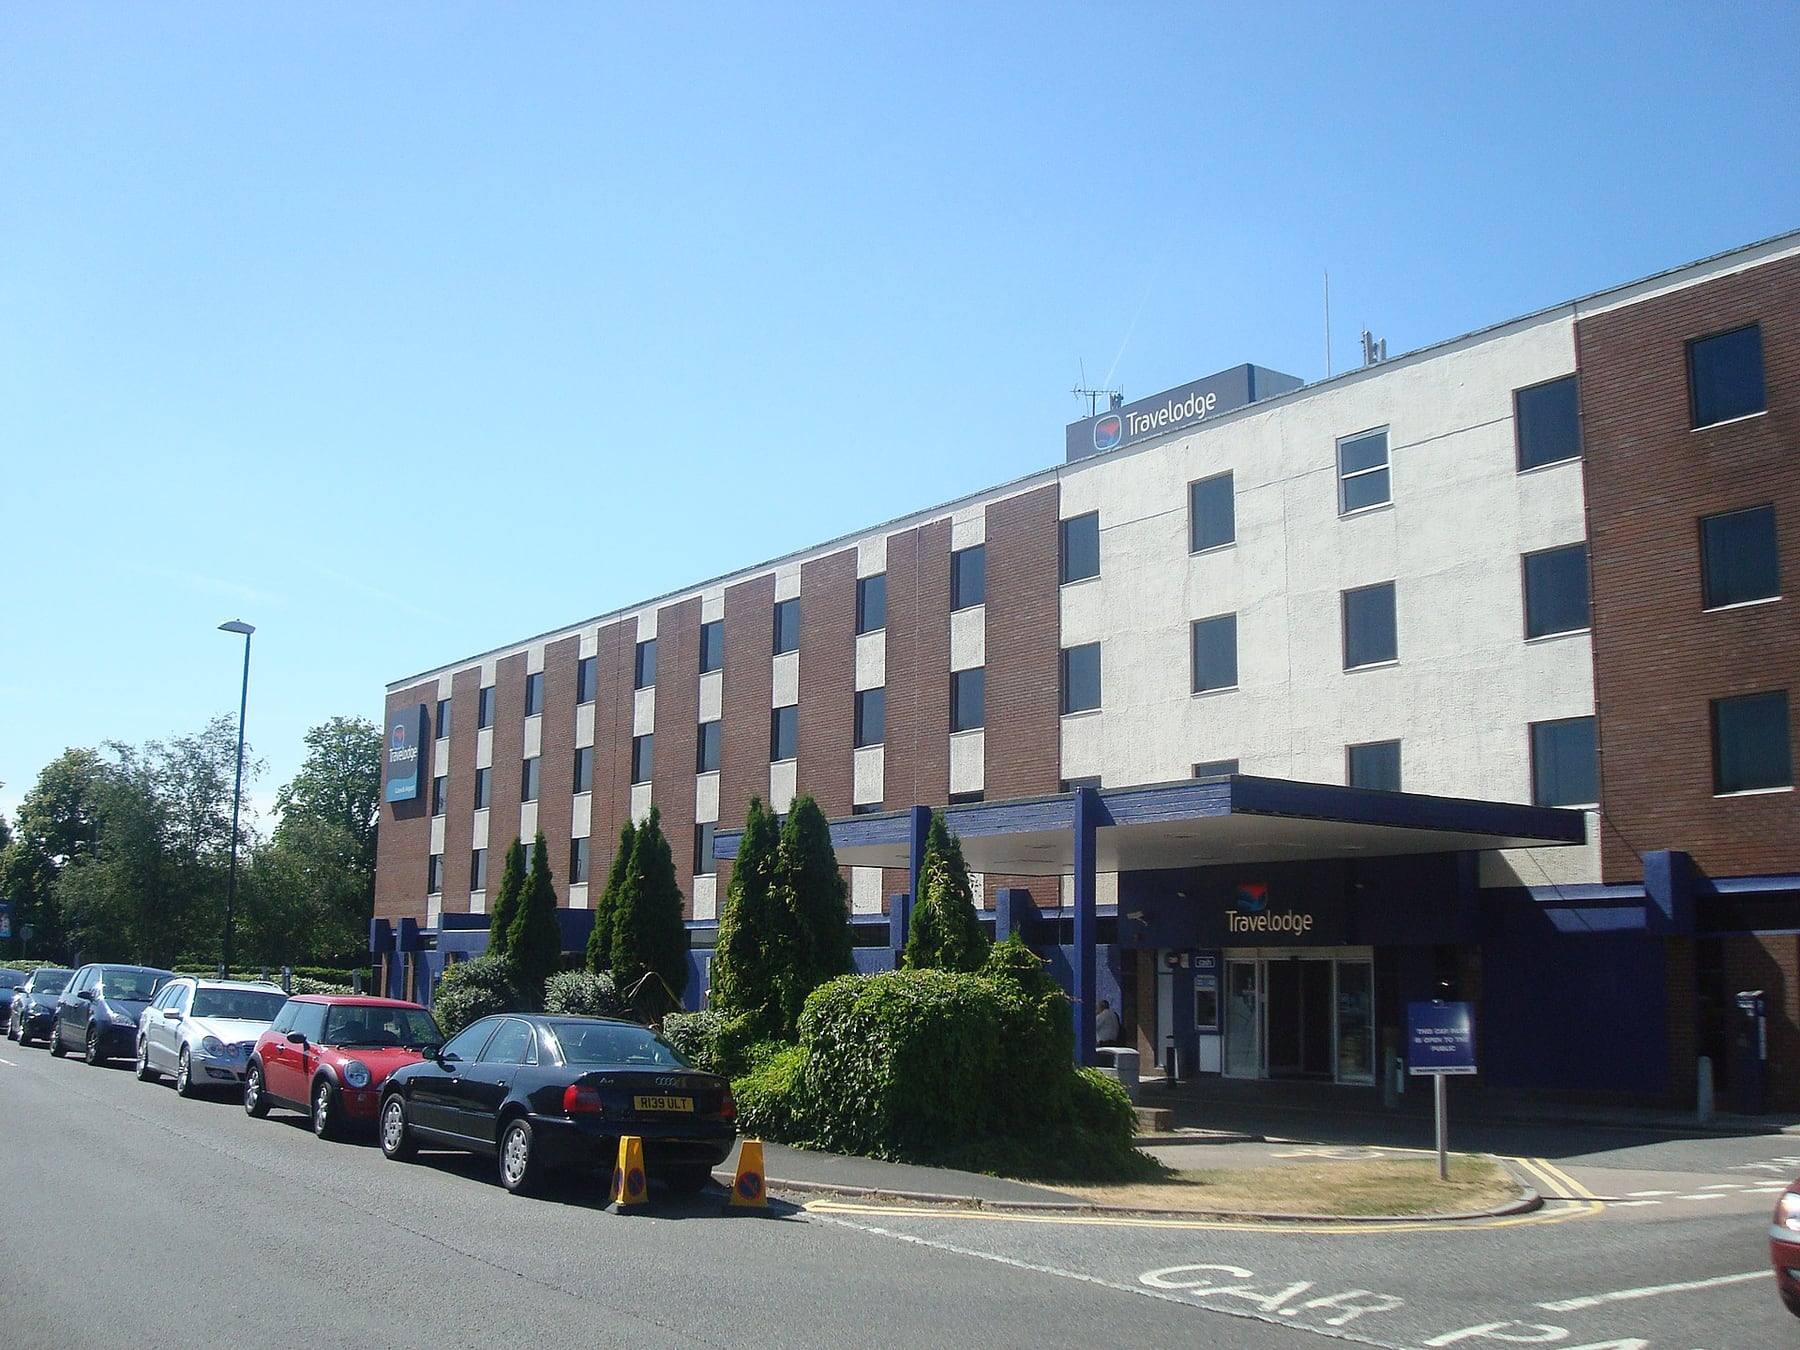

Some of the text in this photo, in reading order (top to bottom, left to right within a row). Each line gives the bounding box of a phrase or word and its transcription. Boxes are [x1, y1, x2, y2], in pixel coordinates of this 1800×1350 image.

[1126, 392, 1217, 436] Travelodge
[1225, 909, 1313, 936] Travelodge
[640, 1097, 687, 1109] R139 ULT
[1138, 1263, 1404, 1326] CAR
